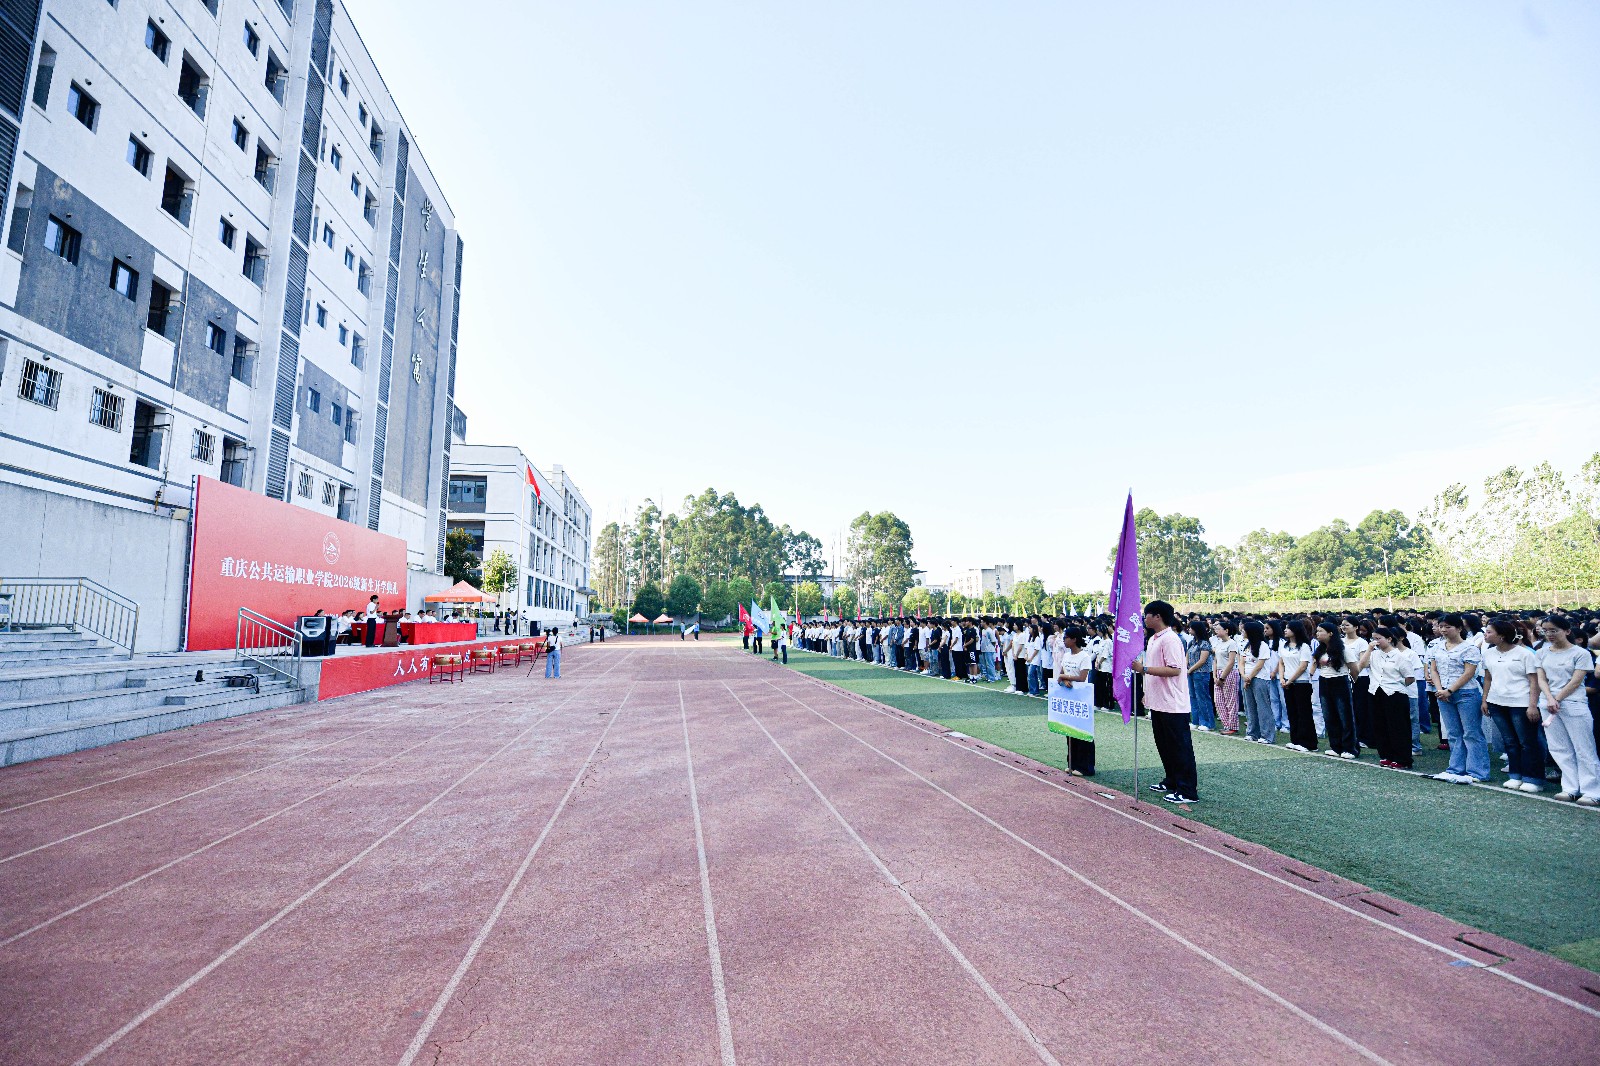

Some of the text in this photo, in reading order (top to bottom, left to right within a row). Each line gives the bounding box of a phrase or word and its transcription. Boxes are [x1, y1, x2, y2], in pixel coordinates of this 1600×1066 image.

[220, 556, 398, 595] 重庆公共运输职业学院2026级新生开学典礼
[1051, 697, 1089, 719] 运输贸易学院
